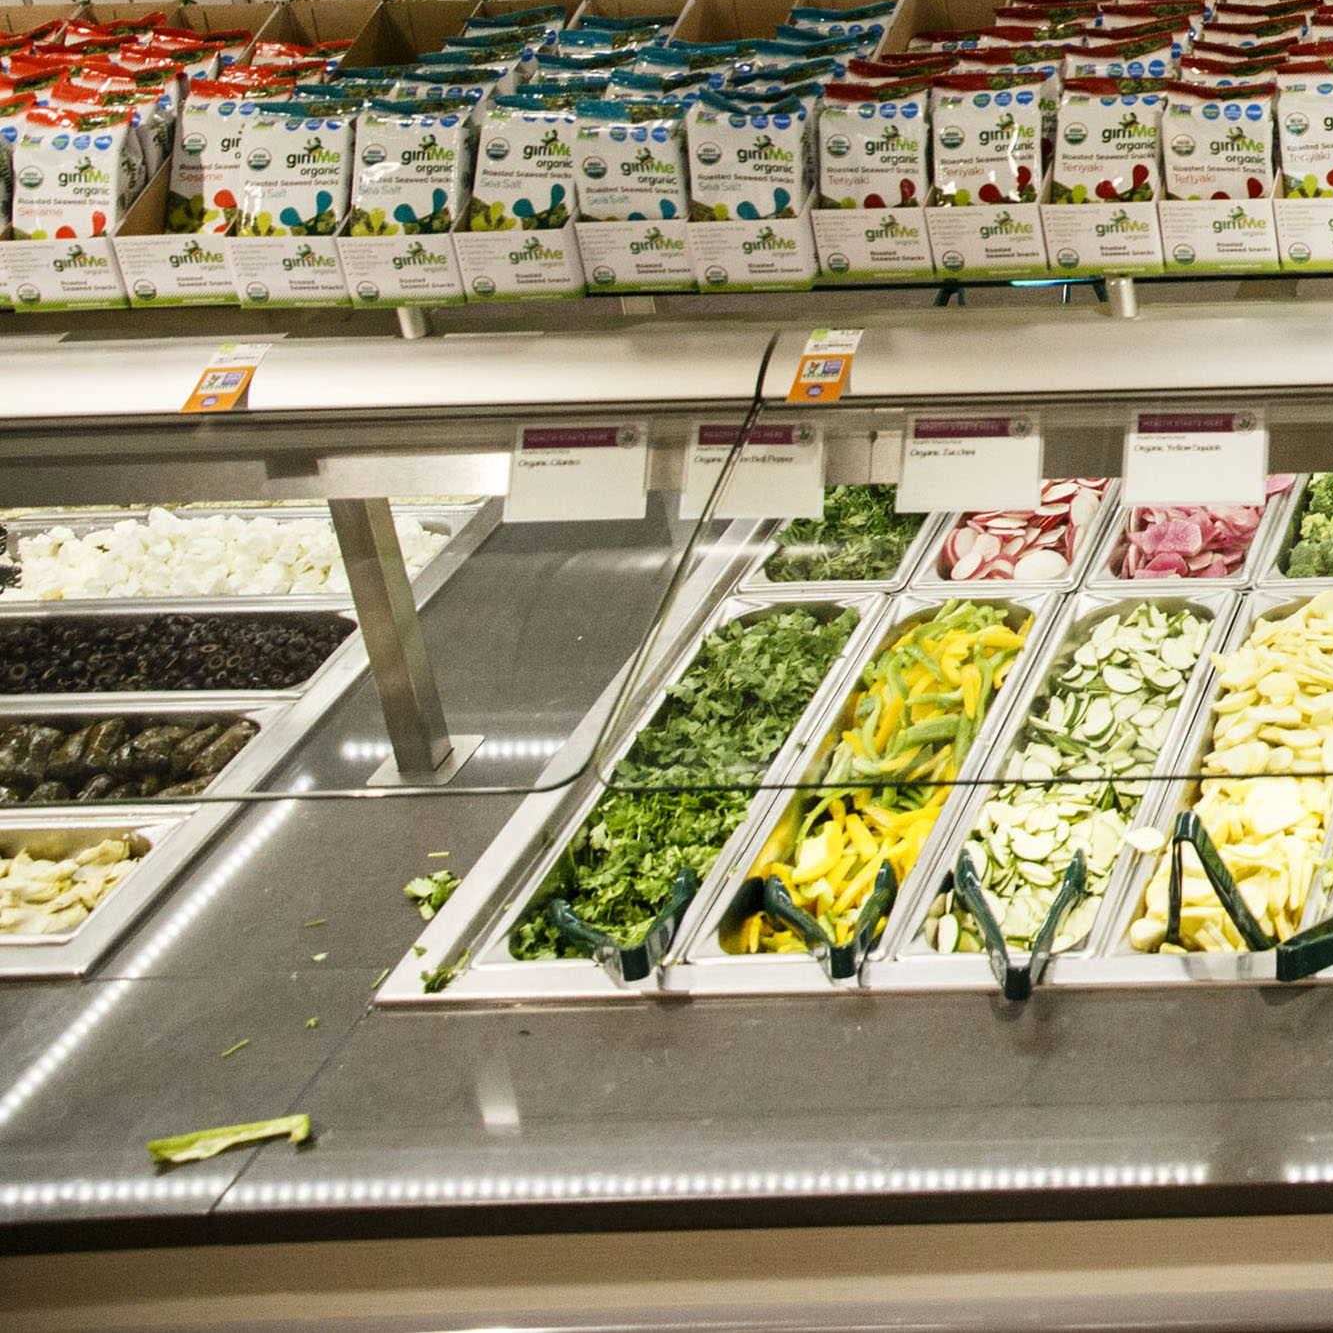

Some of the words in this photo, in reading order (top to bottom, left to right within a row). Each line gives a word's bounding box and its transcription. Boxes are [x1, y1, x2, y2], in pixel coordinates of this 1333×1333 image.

[1102, 125, 1157, 143] gimMe
[737, 146, 795, 164] gimMe
[865, 138, 919, 155] gimMe
[1115, 140, 1157, 153] organic
[1210, 138, 1265, 155] gimMe
[286, 150, 341, 169] gimMe
[401, 147, 455, 164] gimMe
[880, 154, 919, 166] organic
[1225, 154, 1266, 167] organic
[300, 165, 341, 179] organic
[415, 163, 454, 175] organic
[621, 160, 675, 177] gimMe
[753, 162, 795, 175] organic
[638, 174, 678, 187] organic
[865, 226, 919, 243] gimMe
[1212, 218, 1267, 235] gimMe
[53, 254, 108, 272] gimMe
